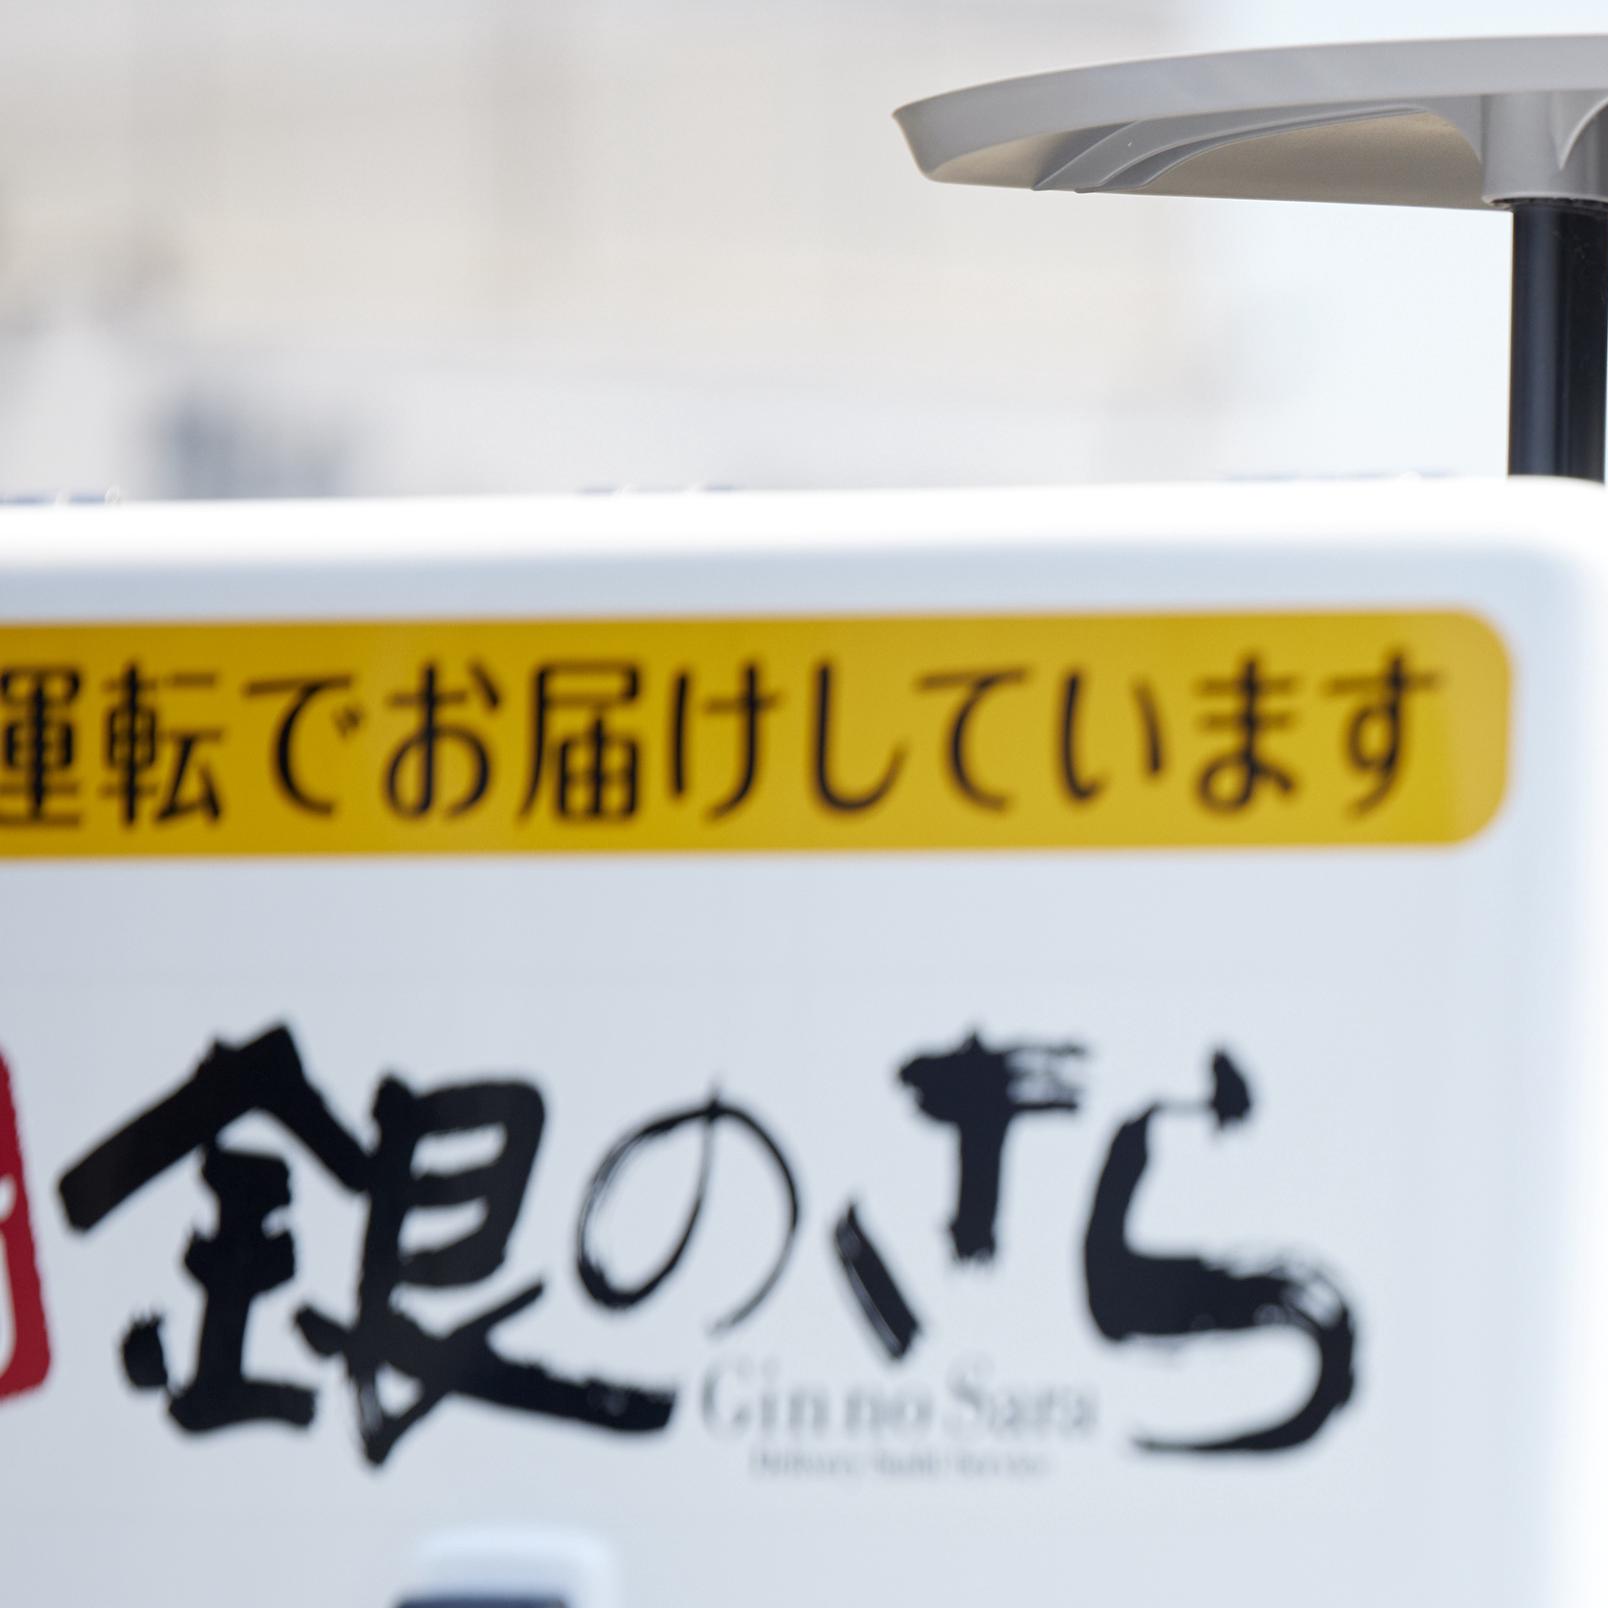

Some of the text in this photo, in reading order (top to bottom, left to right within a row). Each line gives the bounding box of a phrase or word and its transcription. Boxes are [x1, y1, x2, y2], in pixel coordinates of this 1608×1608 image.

[56, 1020, 1357, 1468] 銀のさら
[697, 1352, 831, 1442] Gin
[943, 1350, 1102, 1442] Sara
